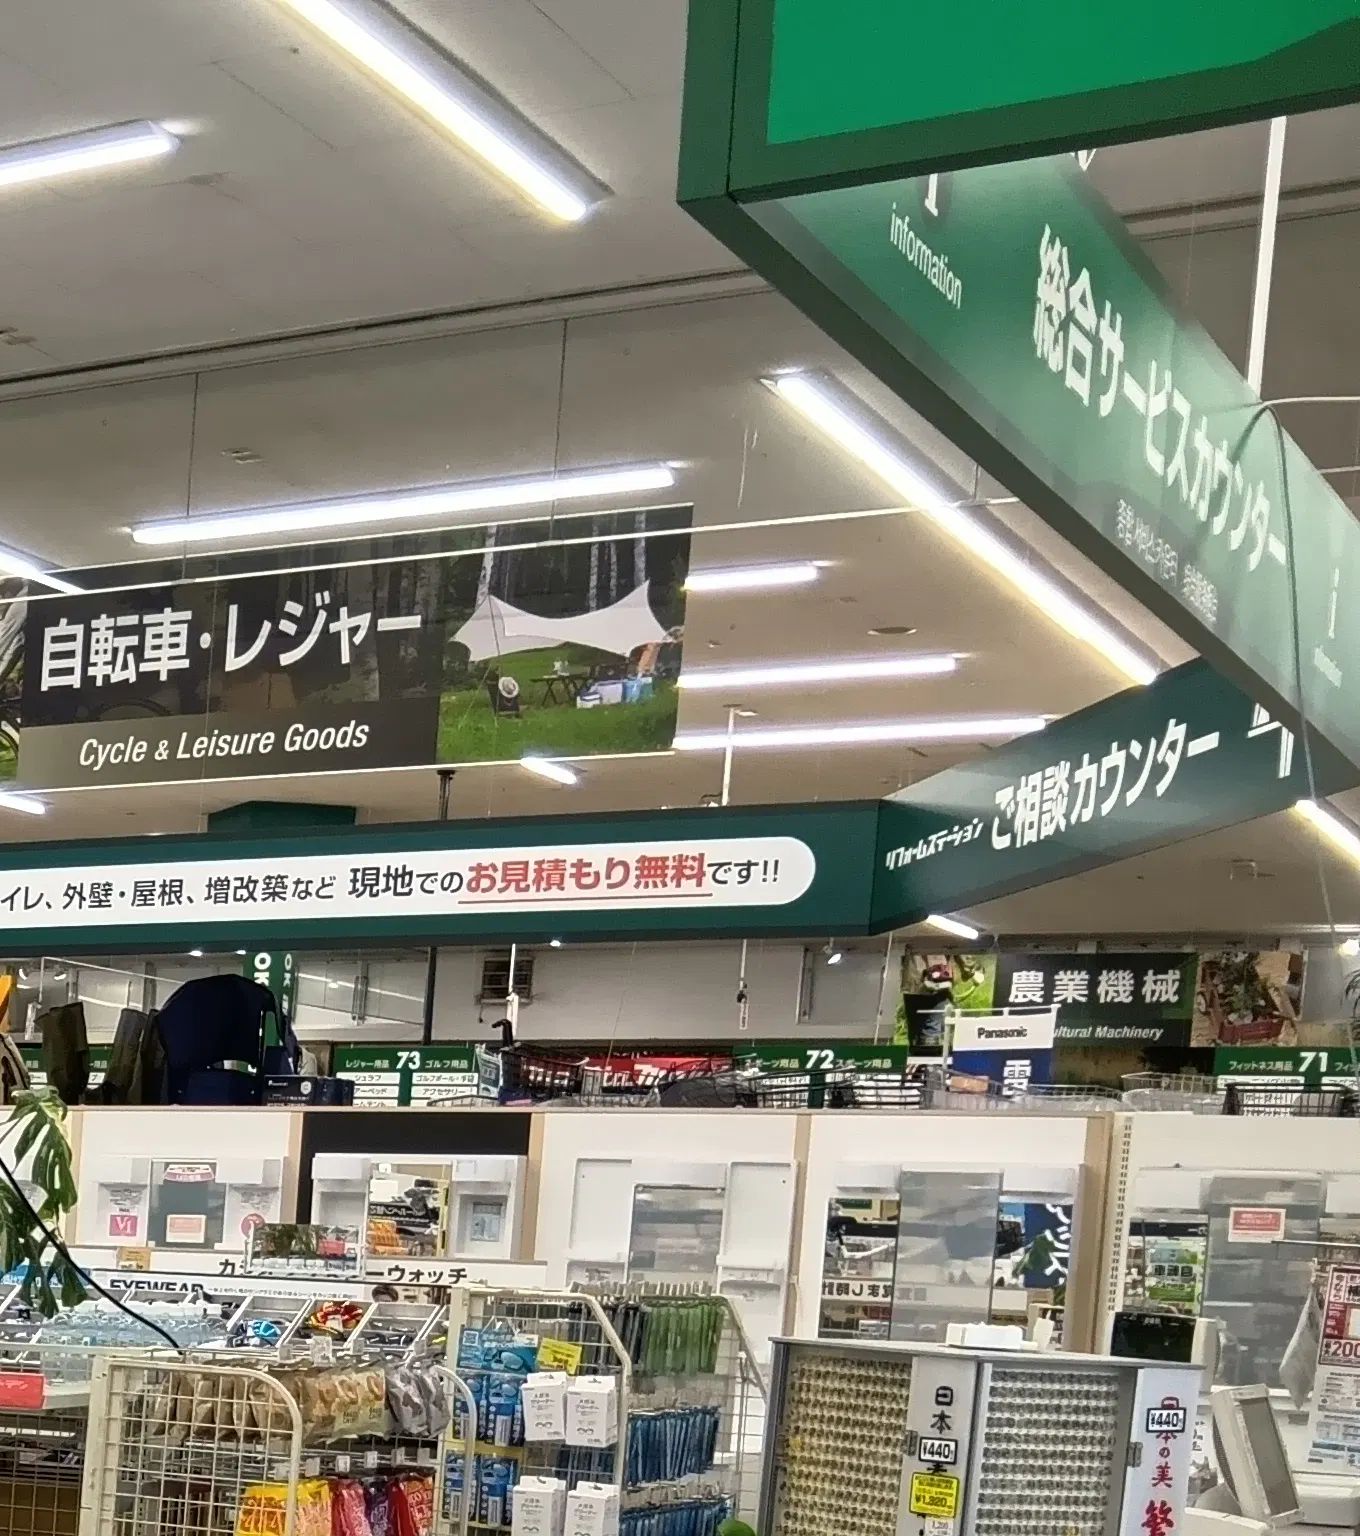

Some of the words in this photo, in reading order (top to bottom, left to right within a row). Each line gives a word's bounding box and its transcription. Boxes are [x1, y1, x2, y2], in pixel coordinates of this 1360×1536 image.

[890, 202, 963, 310] information
[1032, 222, 1287, 571] 総合サービスカウンター
[39, 597, 422, 693] 自転車・レジャー
[79, 732, 146, 768] Cycle
[154, 738, 170, 761] &
[177, 722, 275, 762] Leisure
[283, 718, 370, 755] Goods
[990, 718, 1221, 852] ご相談カウンター
[1008, 968, 1181, 1005] 農業機械
[977, 1026, 1029, 1040] Panasonic
[1094, 1024, 1165, 1042] Machinery
[395, 1051, 421, 1070] 73
[424, 1058, 469, 1070] ゴルフ用品
[805, 1049, 834, 1069] 72
[1299, 1051, 1329, 1072] 71
